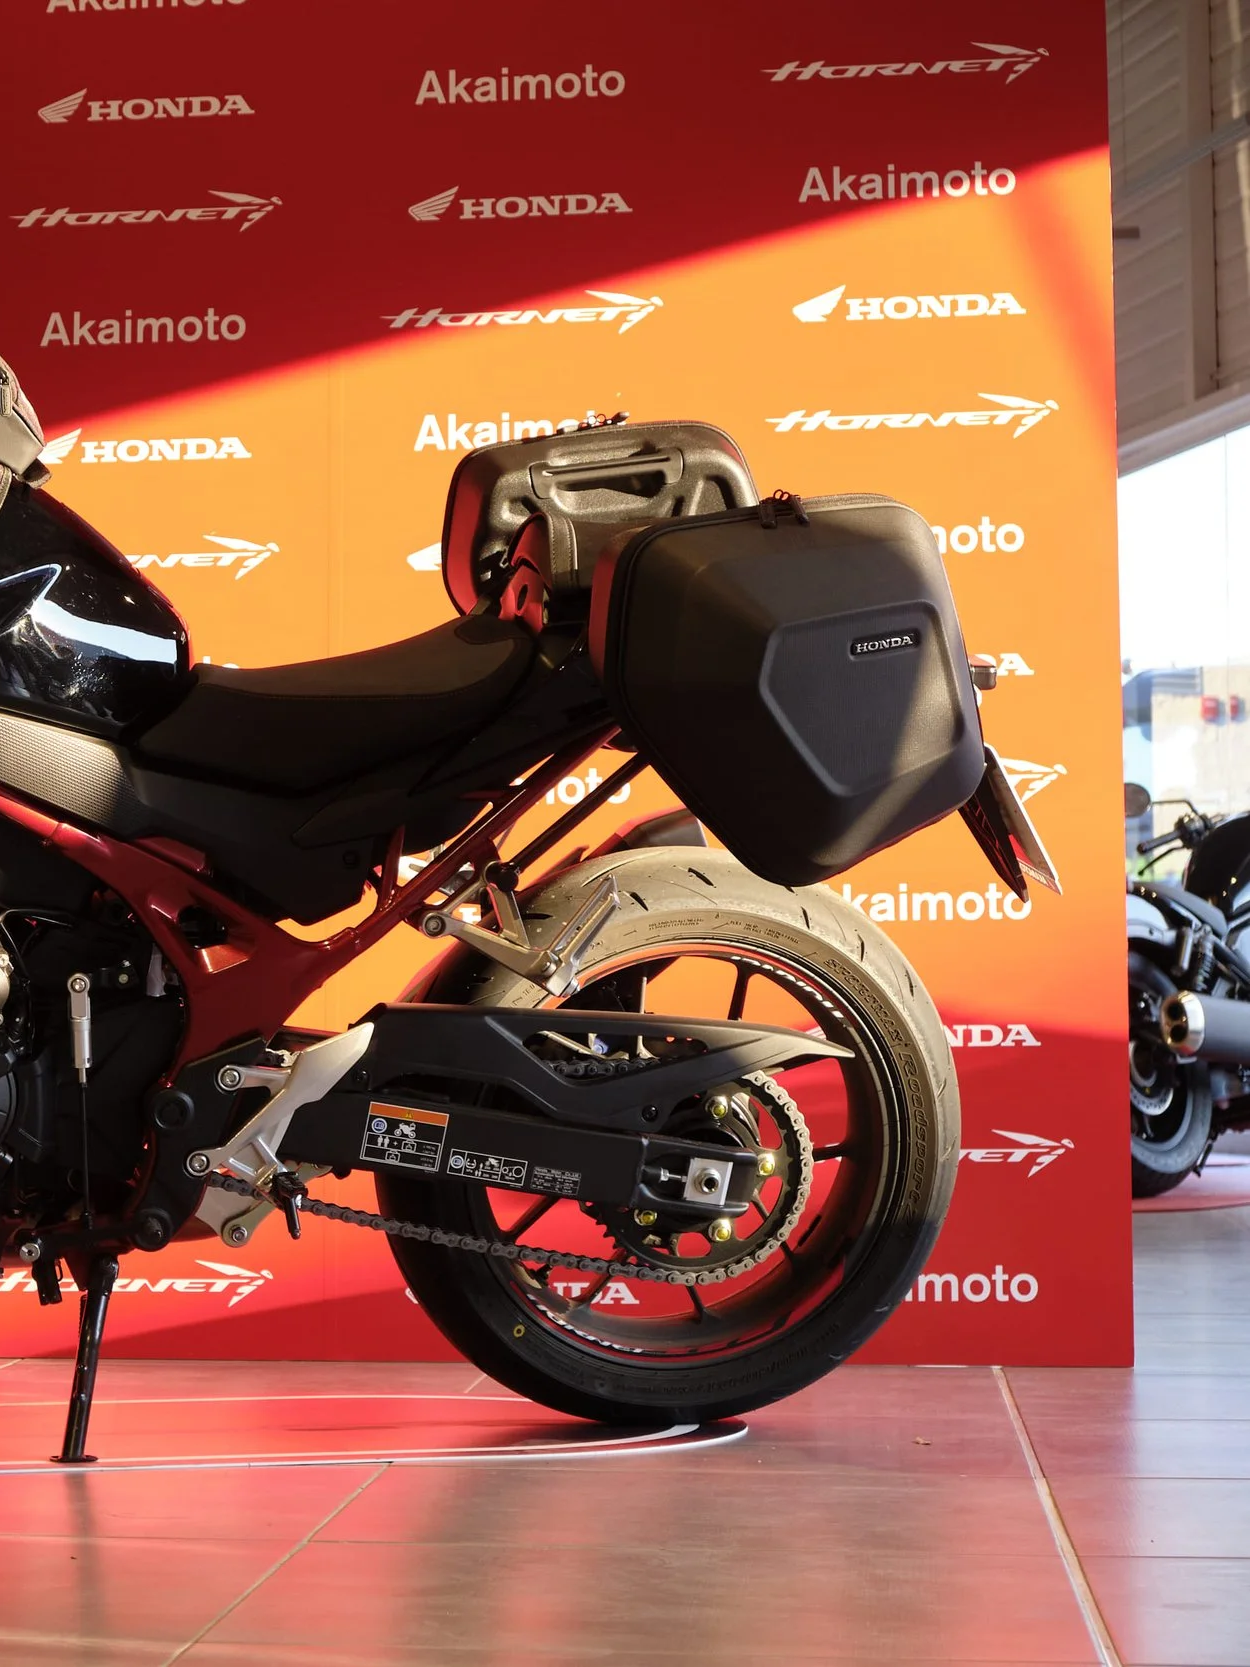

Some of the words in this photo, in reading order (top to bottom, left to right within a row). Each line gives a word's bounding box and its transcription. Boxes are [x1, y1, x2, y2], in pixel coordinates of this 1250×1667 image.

[762, 57, 1027, 82] HORNET
[415, 63, 626, 105] Akaimoto
[88, 94, 256, 122] HONDA
[799, 160, 1017, 202] Akaimoto
[10, 205, 261, 229] HORNET
[460, 192, 634, 219] HONDA
[384, 305, 639, 330] HORNET
[846, 292, 1027, 321] HONDA
[40, 307, 247, 347] Akaimoto
[766, 407, 1036, 433] HORNET
[81, 436, 252, 464] HONDA
[855, 635, 914, 653] HONDA
[844, 881, 1033, 922] kaimoto
[944, 1023, 1042, 1048] NDA
